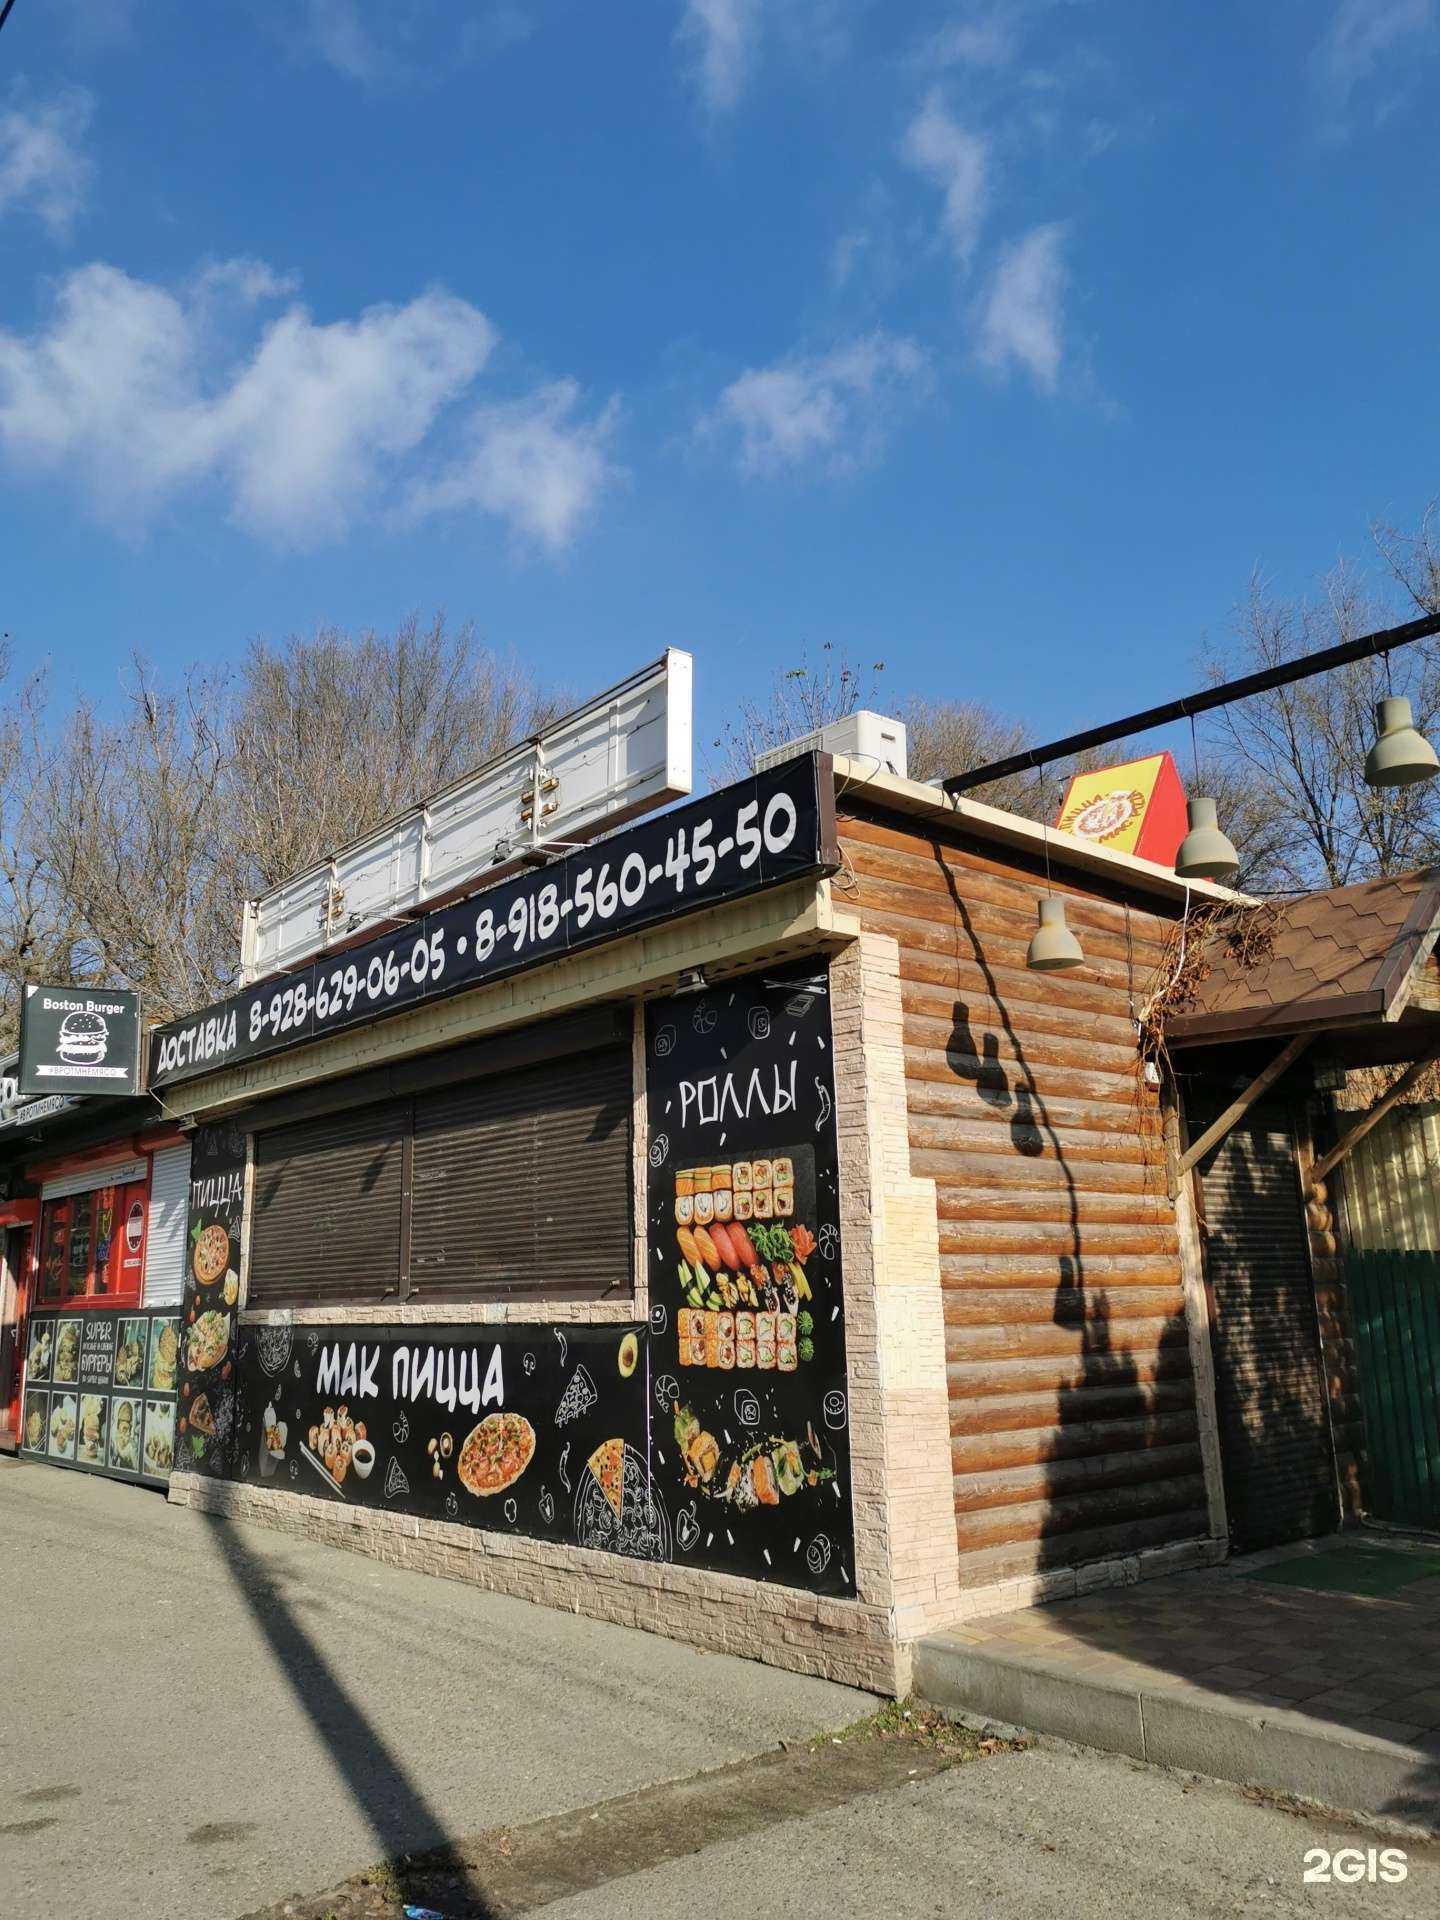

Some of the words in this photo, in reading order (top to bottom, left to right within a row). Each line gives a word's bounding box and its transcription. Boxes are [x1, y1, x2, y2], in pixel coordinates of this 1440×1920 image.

[157, 1010, 237, 1075] ДОСТАВКА
[249, 928, 445, 1042] 8-928-629-06-05
[475, 791, 799, 963] 8-918-560-45-50
[43, 998, 83, 1011] Boston
[86, 1001, 125, 1014] Burger
[680, 1060, 798, 1128] РОЛЛЫ
[192, 1173, 242, 1217] ПИЦЦА
[86, 1321, 111, 1340] SUPER
[316, 1343, 379, 1396] МАК
[392, 1343, 504, 1414] ПИЦЦА
